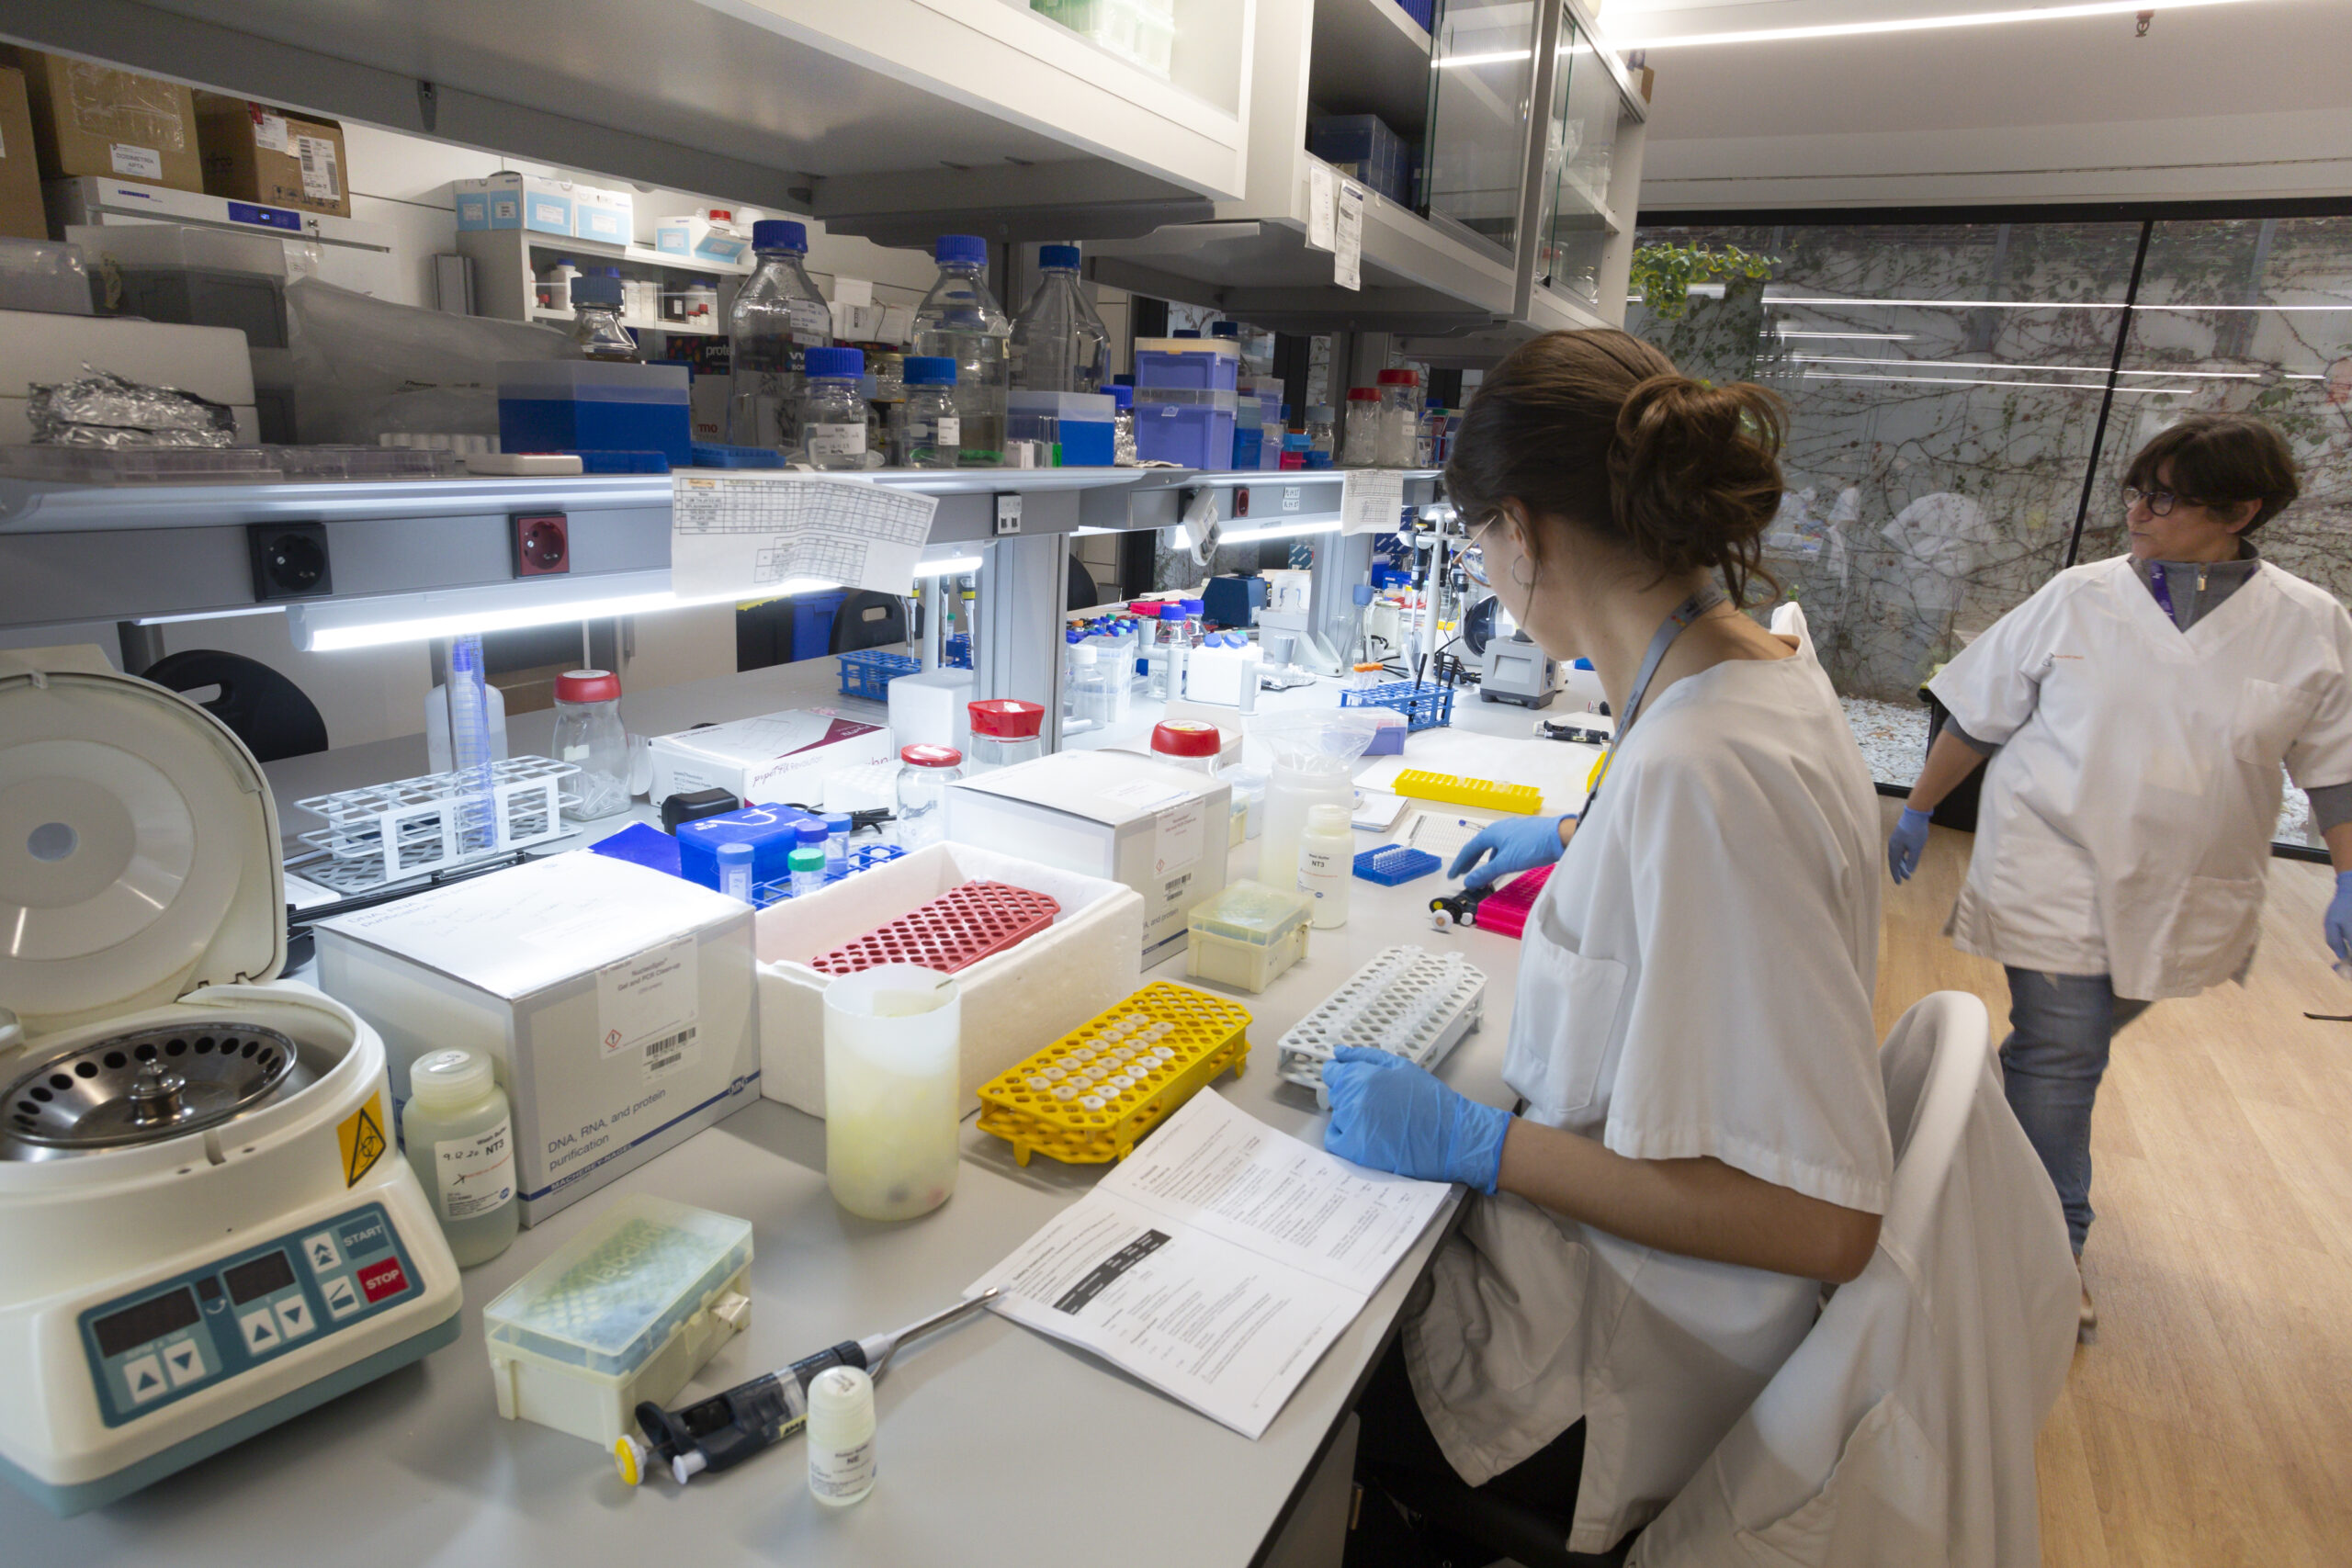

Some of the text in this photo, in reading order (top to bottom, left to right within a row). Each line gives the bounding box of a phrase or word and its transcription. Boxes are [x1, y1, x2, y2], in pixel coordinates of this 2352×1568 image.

[1311, 860, 1325, 868] NT3
[548, 1089, 667, 1154] DNA, RNA, and protein
[485, 1138, 504, 1156] NT3
[548, 1134, 610, 1172] purification
[344, 1224, 384, 1247] START
[365, 1269, 401, 1291] STOP
